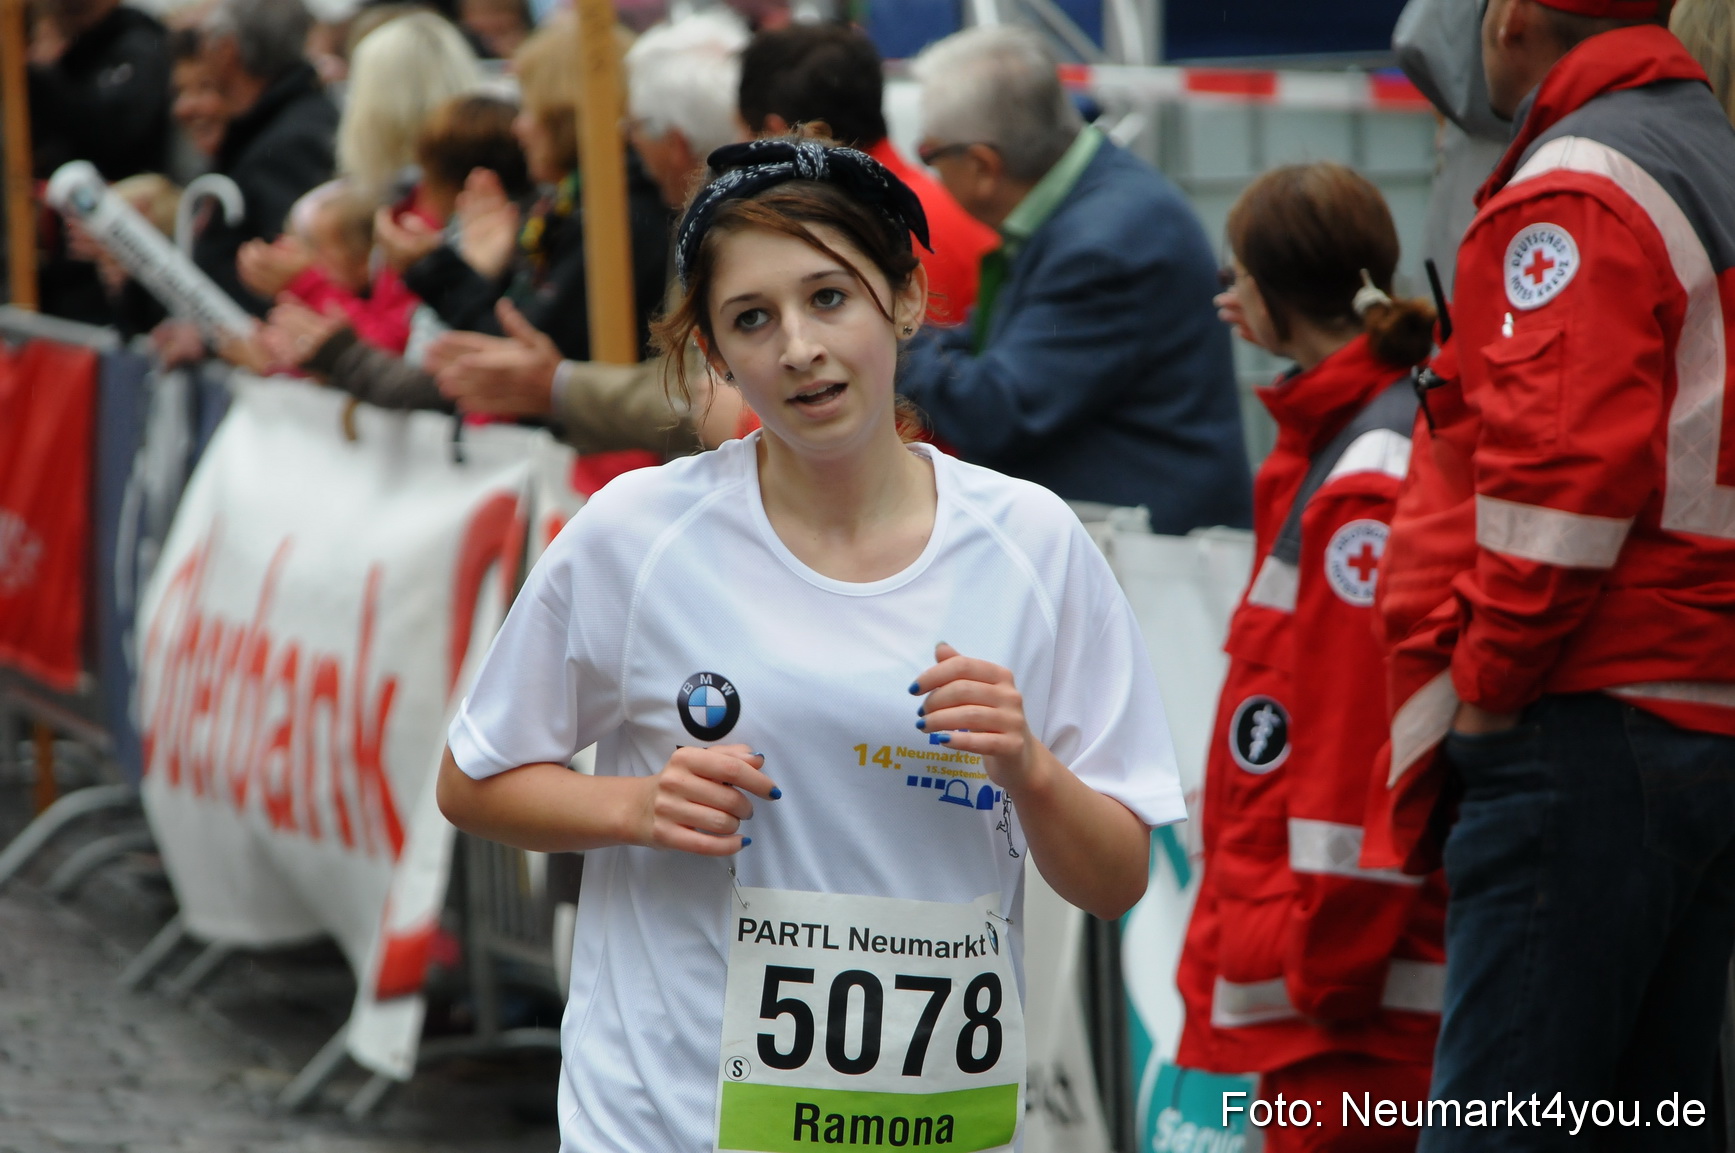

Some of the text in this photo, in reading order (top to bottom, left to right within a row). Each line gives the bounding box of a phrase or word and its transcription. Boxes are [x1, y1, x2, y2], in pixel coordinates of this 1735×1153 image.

[1511, 231, 1567, 268] DEUTSCHES
[1511, 259, 1570, 300] ROTES KREUZ
[682, 673, 735, 696] BMW
[853, 743, 982, 770] 14. Neumarkter
[737, 917, 986, 959] PARTL Neumarkt
[756, 964, 1003, 1077] 5078
[792, 1102, 955, 1147] Ramona
